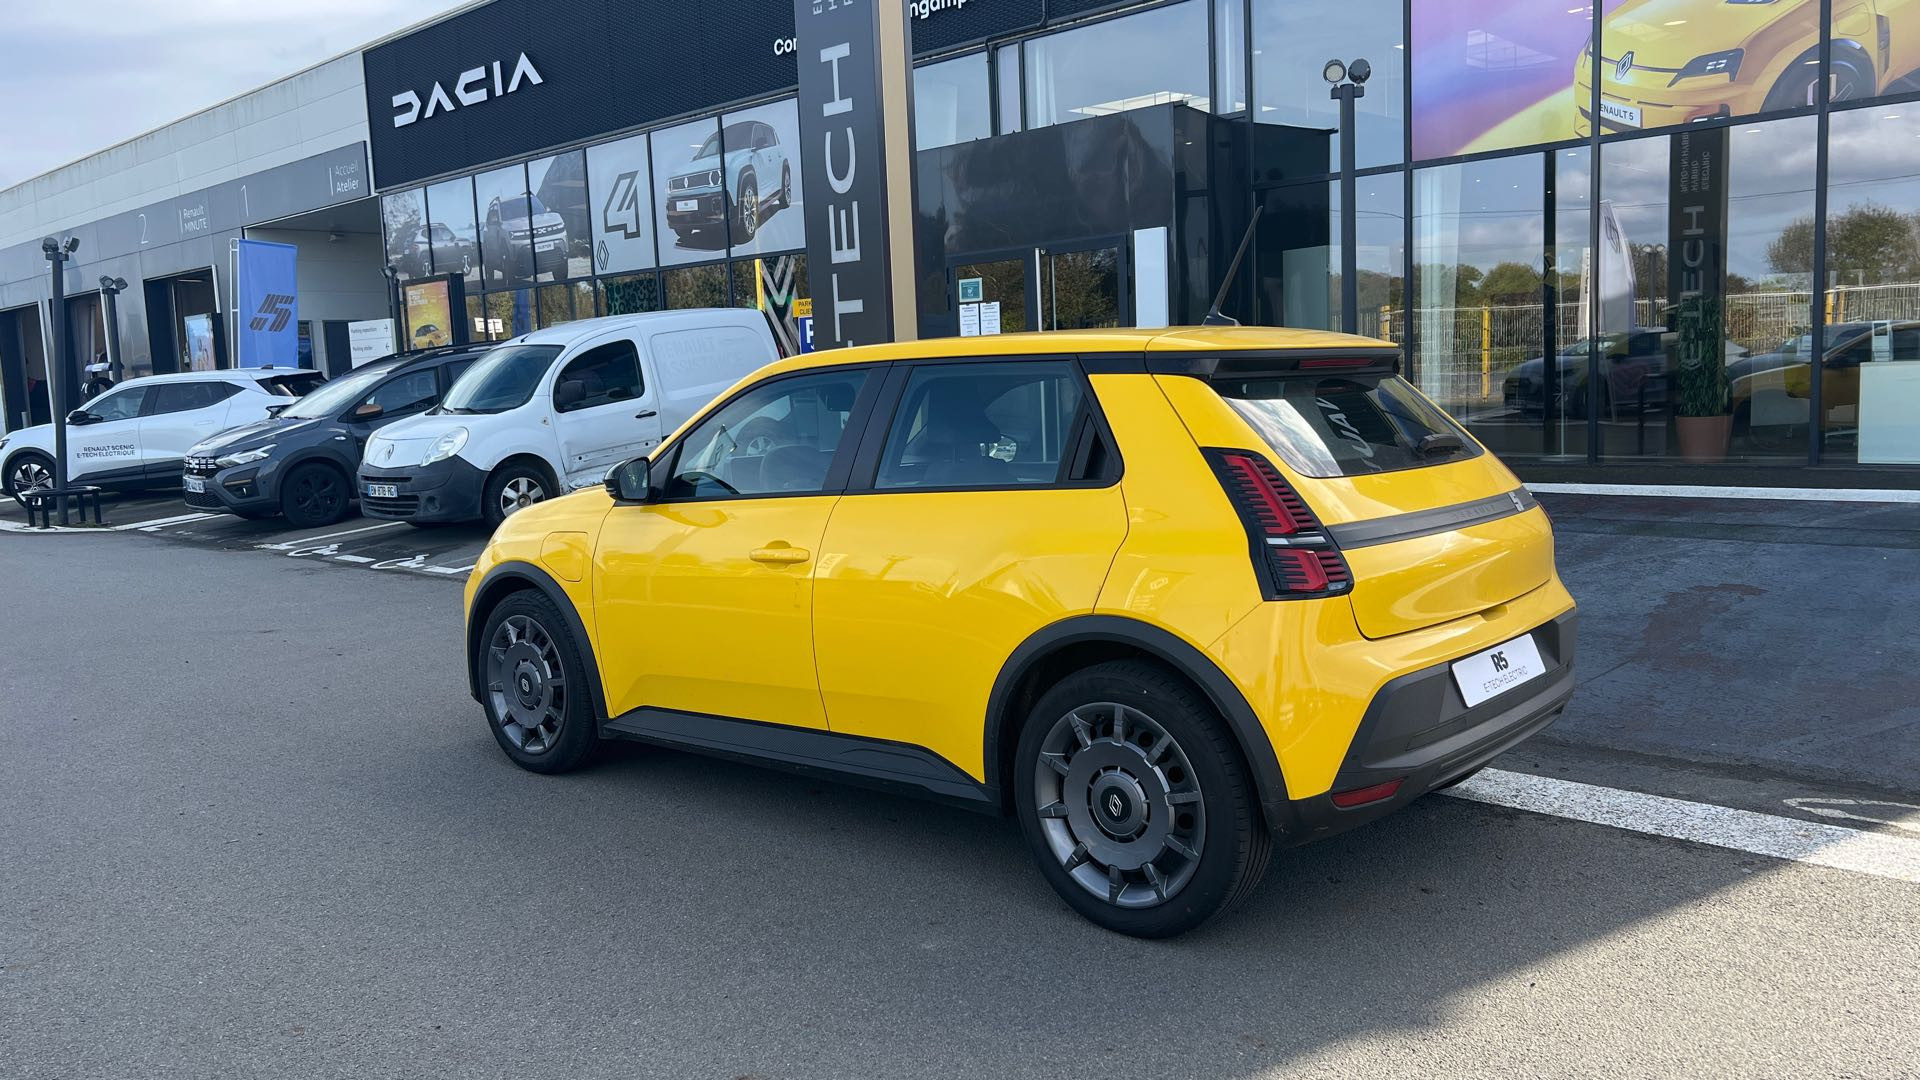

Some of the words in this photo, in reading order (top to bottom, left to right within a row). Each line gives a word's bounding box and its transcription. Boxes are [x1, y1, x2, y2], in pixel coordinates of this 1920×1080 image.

[392, 52, 544, 128] DACIA
[1600, 104, 1627, 119] ENAULT
[1629, 112, 1634, 121] 5
[335, 160, 358, 176] Accueil
[336, 178, 359, 193] Atelier
[819, 42, 864, 348] TECH
[240, 184, 249, 217] 1
[604, 170, 640, 240] 4
[183, 205, 205, 219] Renault
[138, 213, 150, 244] 2
[184, 217, 208, 232] MINUTE
[83, 445, 110, 453] RENAULT
[98, 449, 136, 457] ELECTRIQUE
[1490, 650, 1510, 673] R5
[1483, 677, 1505, 693] E-TECH
[1503, 665, 1528, 684] ELECTRIC
